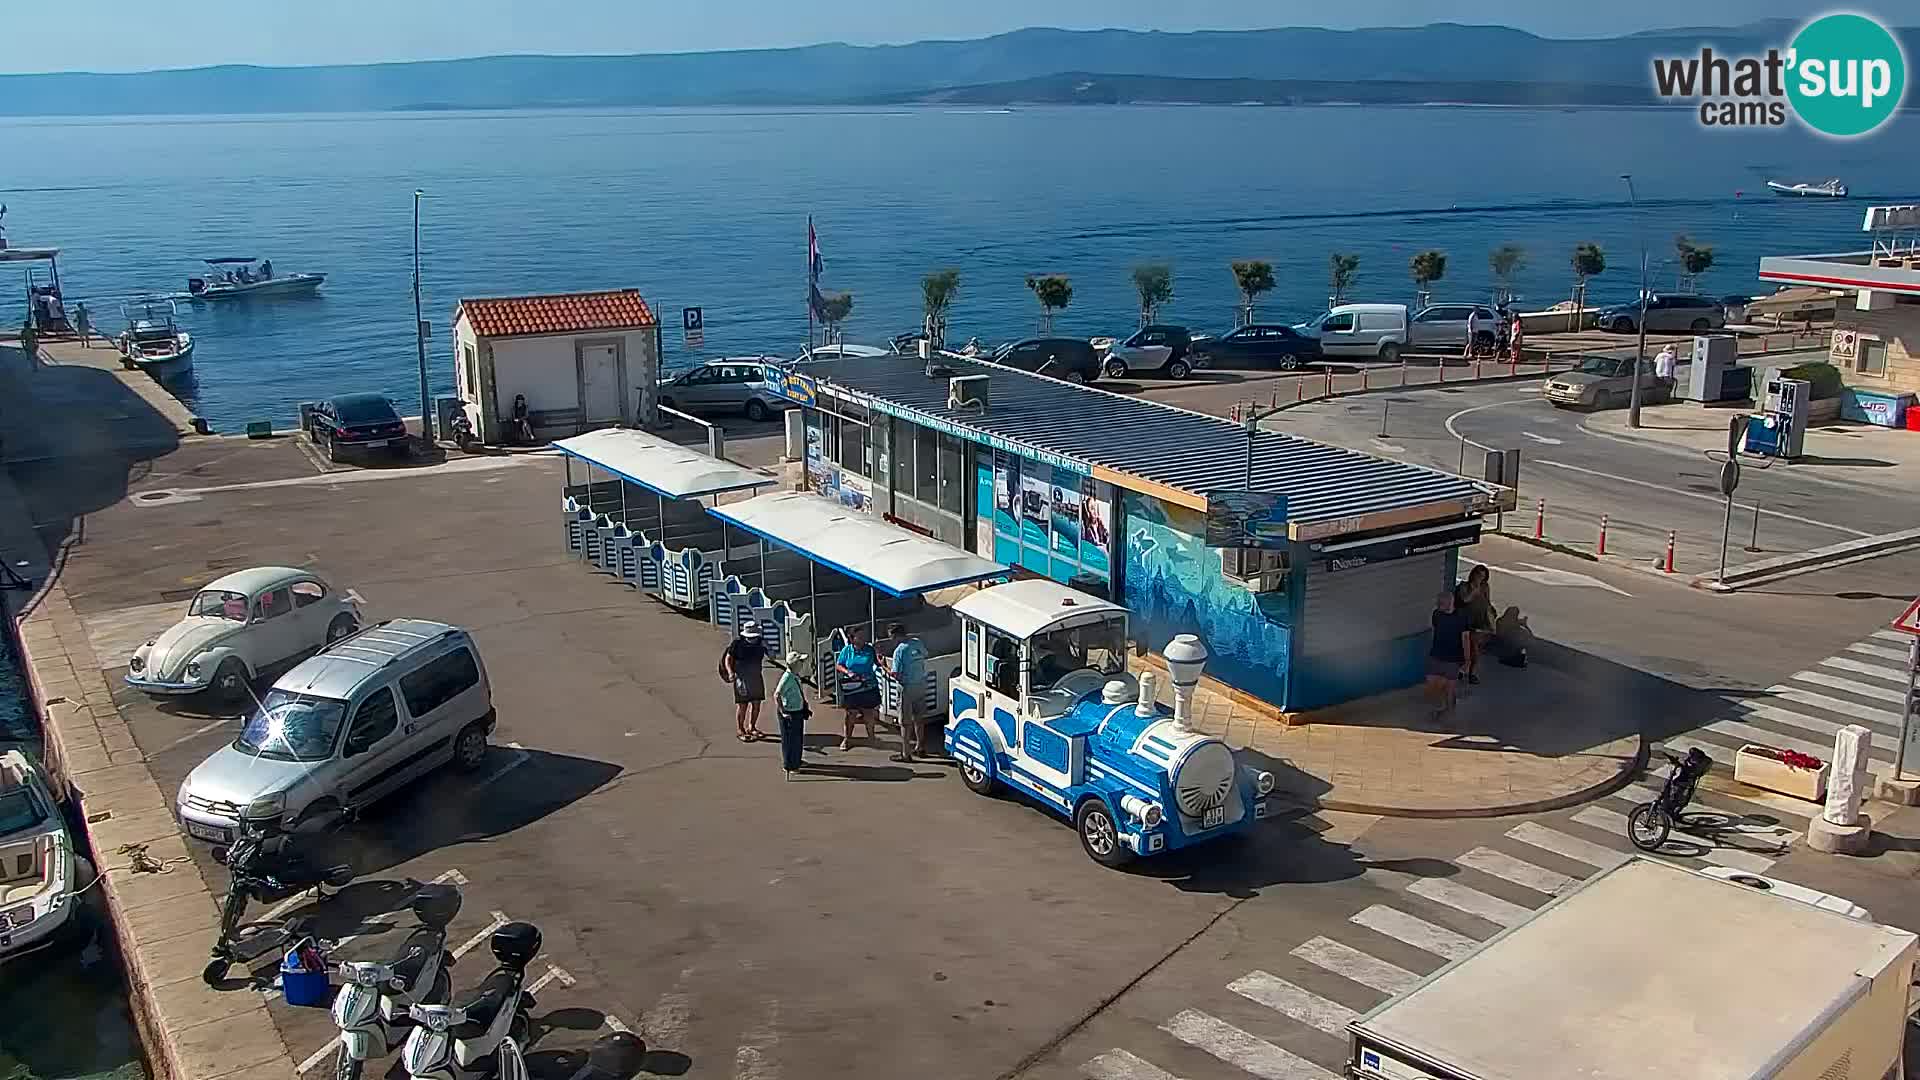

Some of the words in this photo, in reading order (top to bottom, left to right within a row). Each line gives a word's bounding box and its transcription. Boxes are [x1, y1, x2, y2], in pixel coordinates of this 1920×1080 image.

[688, 310, 698, 327] P
[915, 412, 952, 434] AUTOBUSNA
[952, 424, 981, 441] POSTAJA
[990, 436, 1004, 449] BUS
[1004, 441, 1034, 457] STATION
[1037, 450, 1061, 465] TICKET
[1062, 458, 1088, 473] OFFICE
